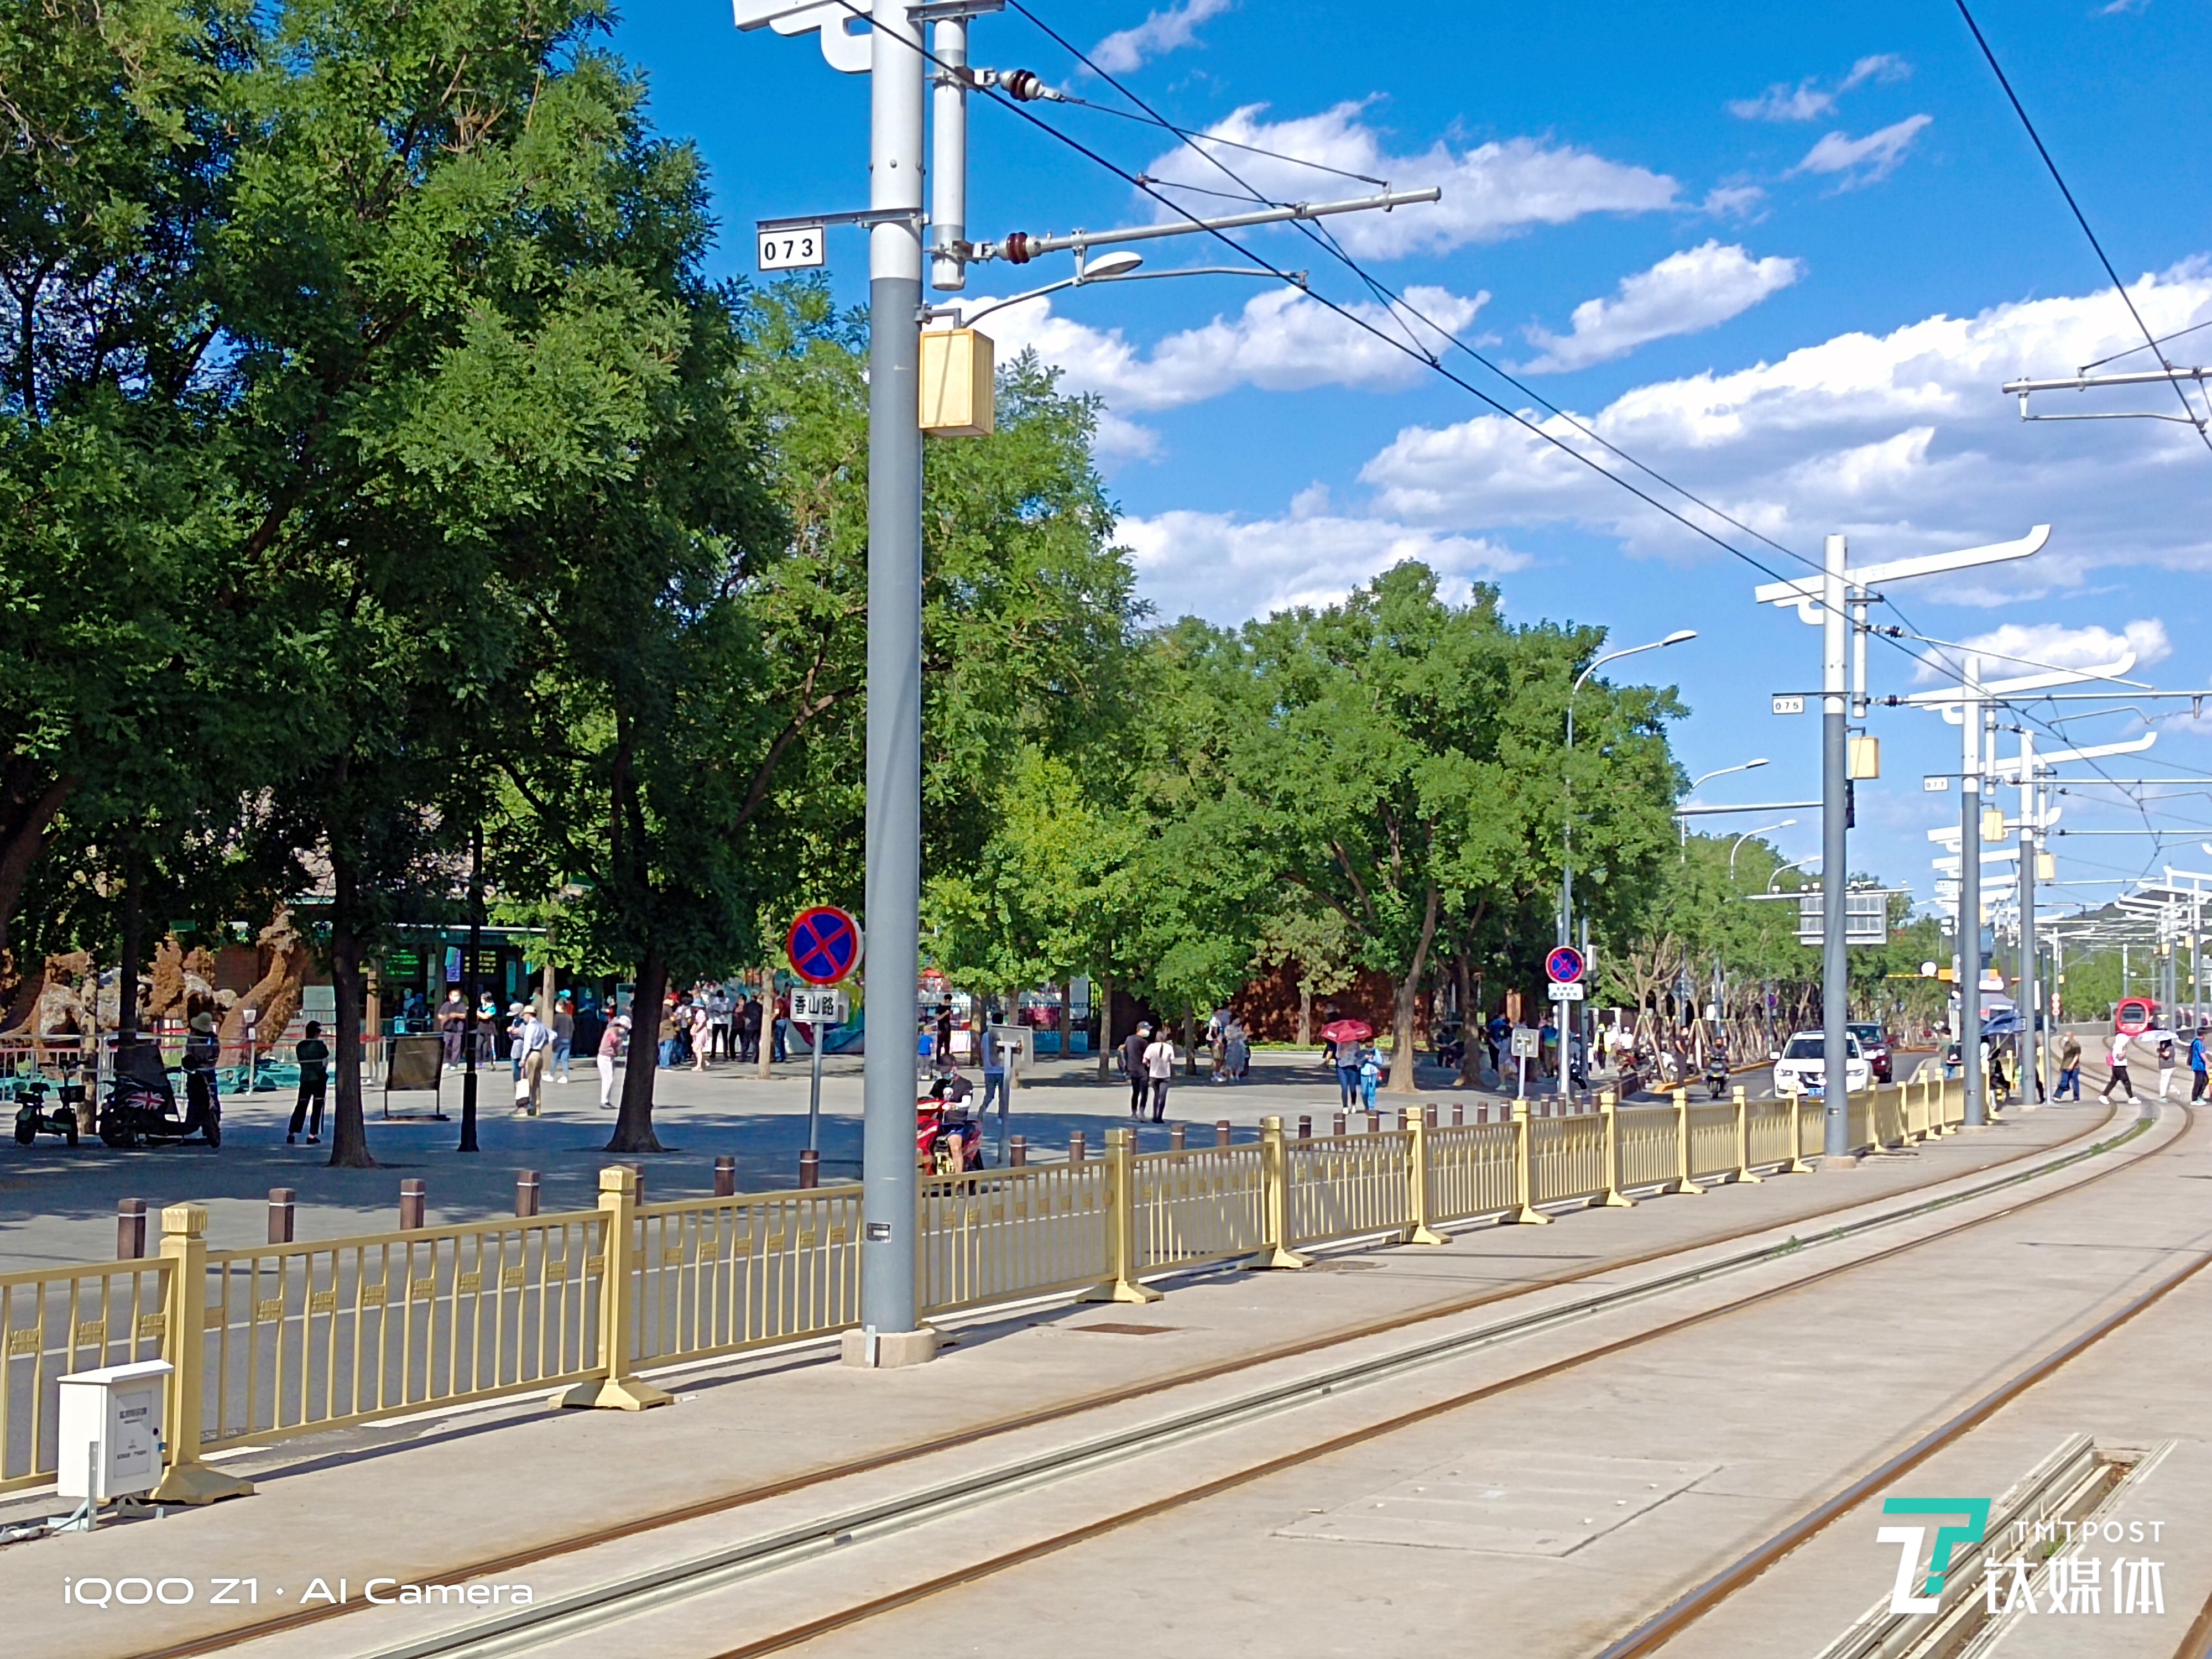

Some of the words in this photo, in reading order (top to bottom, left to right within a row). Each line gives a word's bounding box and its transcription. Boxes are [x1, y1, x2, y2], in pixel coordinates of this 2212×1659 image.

[764, 238, 813, 260] 073
[795, 995, 834, 1015] 香山路
